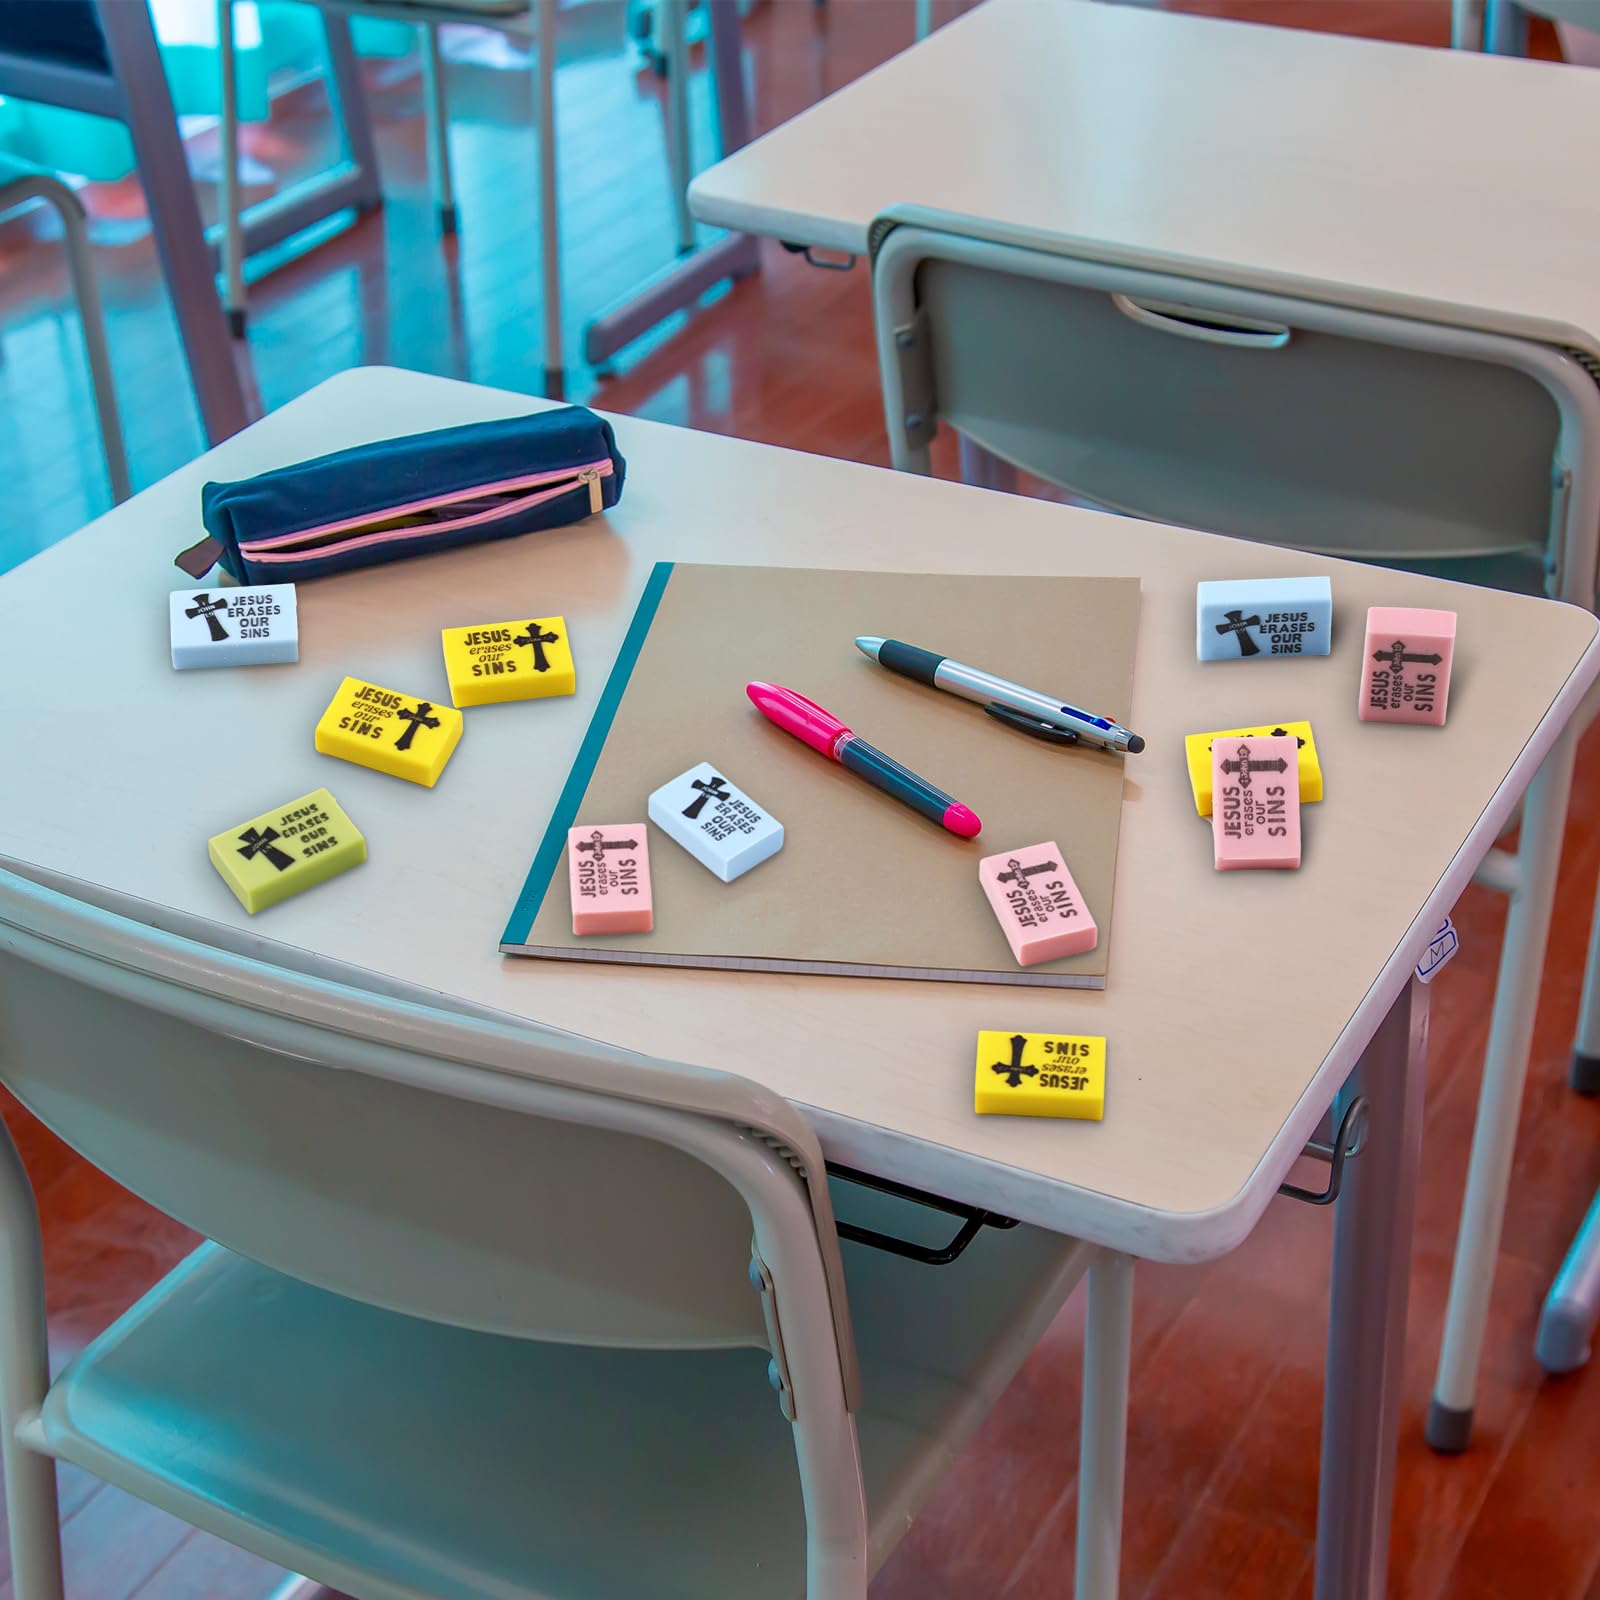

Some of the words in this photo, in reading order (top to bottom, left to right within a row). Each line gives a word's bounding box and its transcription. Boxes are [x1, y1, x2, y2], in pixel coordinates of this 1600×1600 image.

[232, 594, 273, 607] JESUS
[227, 605, 281, 618] ERASES
[1265, 612, 1308, 623] JESUS
[240, 616, 269, 628] OUR
[1260, 622, 1315, 634] ERASES
[240, 628, 270, 639] SINS
[464, 629, 512, 646] JESUS
[1271, 633, 1302, 644] OUR
[469, 643, 512, 655] erases
[479, 653, 504, 663] our
[1271, 644, 1302, 654] SINS
[472, 660, 517, 676] SINS
[354, 686, 402, 710] JESUS
[1370, 671, 1390, 710] JESUS
[1391, 674, 1403, 708] erases
[1403, 684, 1414, 702] our
[1414, 674, 1436, 712] SINS
[352, 700, 394, 718] erases
[354, 710, 380, 723] our
[339, 716, 384, 739] SINS
[280, 803, 318, 826] JESUS
[714, 802, 755, 834] ERASES
[728, 800, 762, 824] JESUS
[1222, 786, 1242, 839] JESUS
[1244, 790, 1254, 836] erases
[1256, 800, 1266, 824] our
[1266, 786, 1287, 836] SINS
[282, 812, 330, 838] ERASES
[700, 822, 726, 841] SINS
[712, 815, 736, 835] OUR
[300, 826, 328, 843] OUR
[302, 836, 338, 858] SINS
[578, 860, 597, 898] JESUS
[597, 862, 608, 896] erases
[609, 870, 619, 887] our
[618, 858, 639, 895] SINS
[1006, 890, 1038, 927] JESUS
[1026, 889, 1048, 922] erases
[1040, 895, 1055, 912] our
[1045, 881, 1078, 918] SINS
[1044, 1041, 1090, 1056] SINS
[1042, 1064, 1087, 1075] erases
[1052, 1056, 1080, 1065] our
[1040, 1073, 1089, 1091] JESUS
